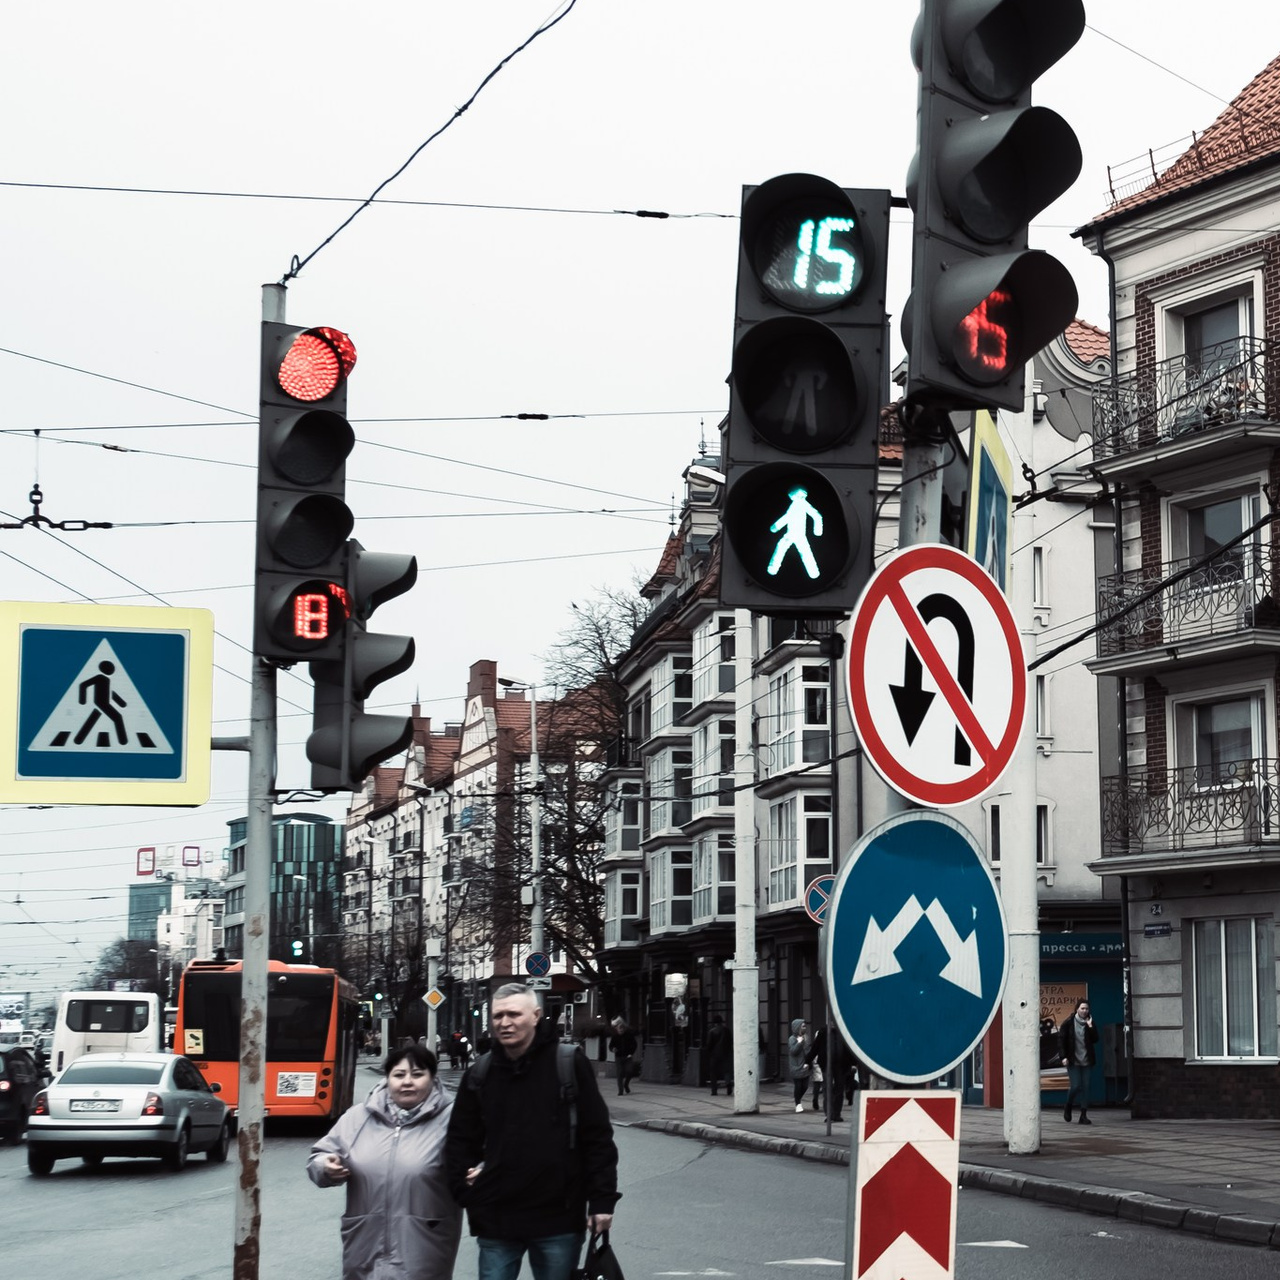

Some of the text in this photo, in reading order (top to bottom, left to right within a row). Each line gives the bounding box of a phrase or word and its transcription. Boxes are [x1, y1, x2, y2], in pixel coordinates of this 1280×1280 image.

[793, 216, 856, 296] 15
[294, 593, 329, 640] 18
[1151, 904, 1162, 915] 24
[1042, 943, 1087, 955] пресса
